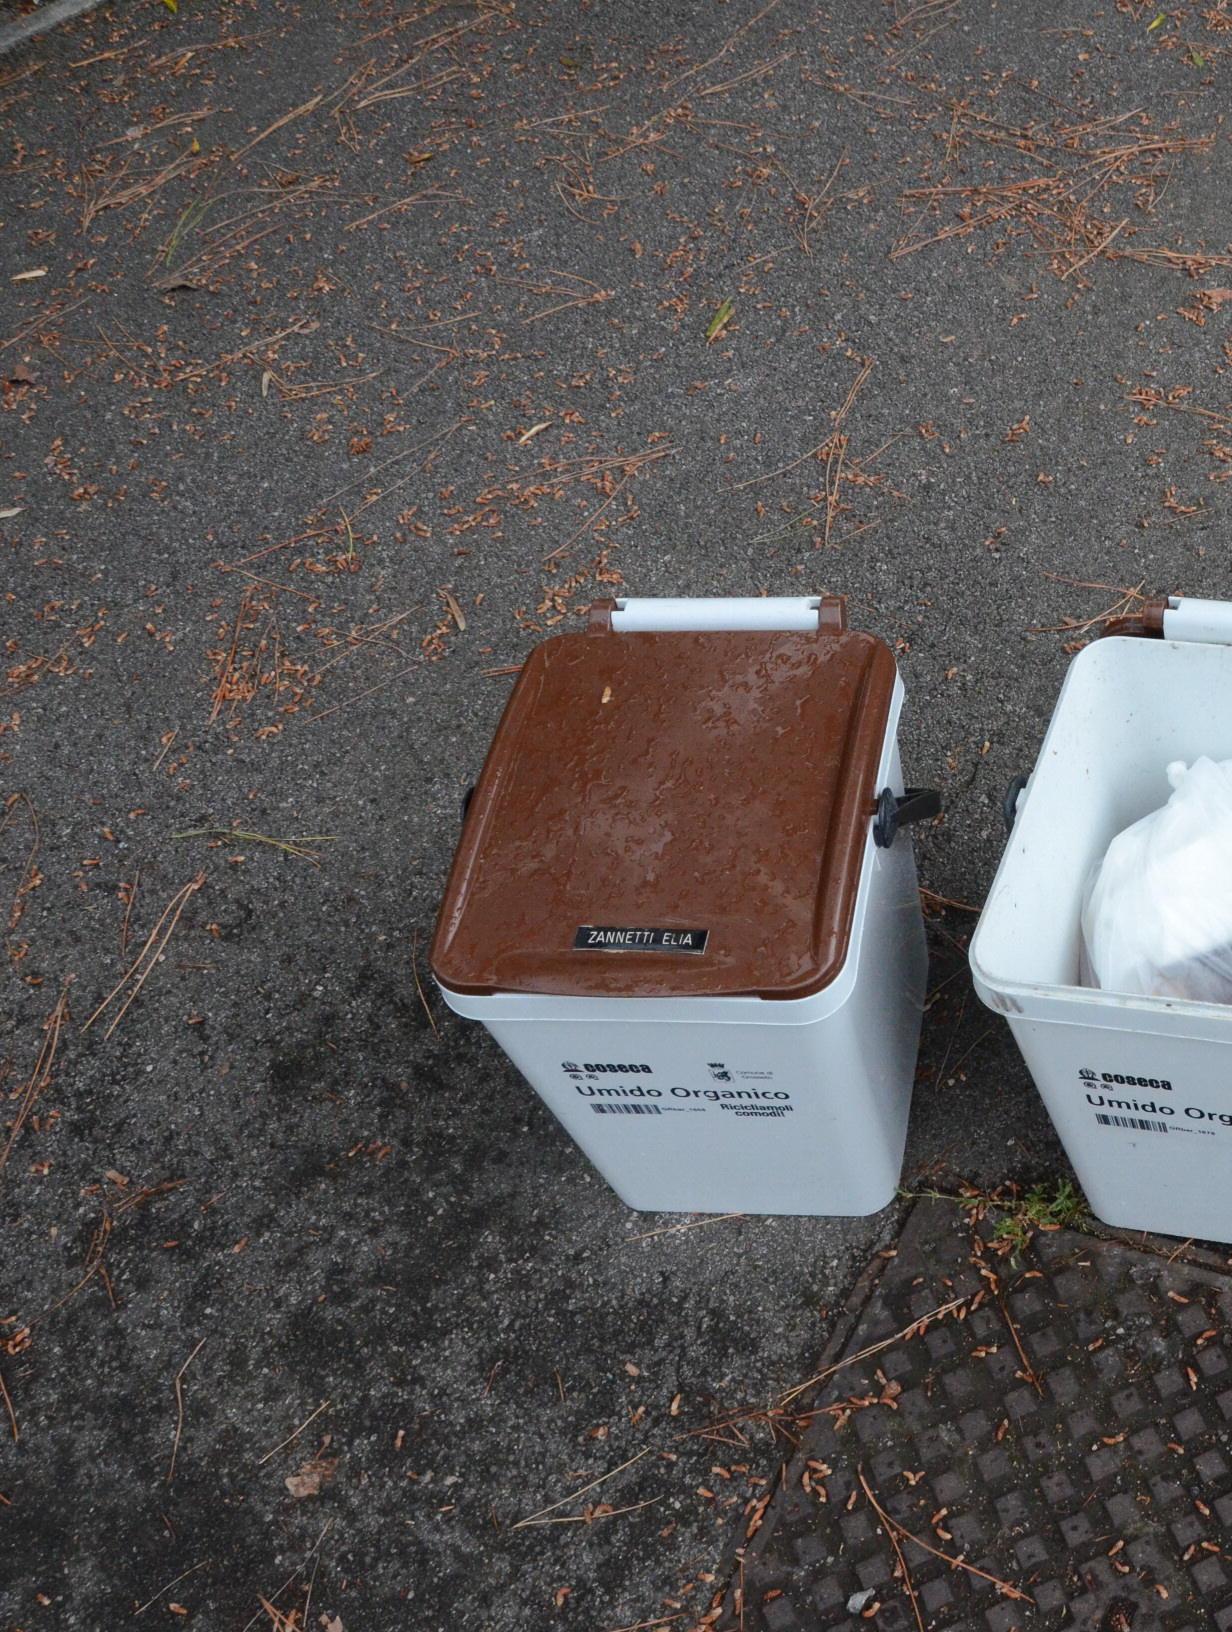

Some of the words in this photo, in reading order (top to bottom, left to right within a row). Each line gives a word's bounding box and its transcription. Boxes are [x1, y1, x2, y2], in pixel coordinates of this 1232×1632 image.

[588, 931, 654, 944] ZANNETTI
[662, 933, 693, 946] ELIA
[1101, 1072, 1172, 1091] coseca
[575, 1085, 662, 1098] Umido
[670, 1087, 790, 1102] Organico
[720, 1103, 794, 1113] Ricicliamoli
[1085, 1093, 1175, 1116] Umido
[735, 1109, 785, 1118] comodi!
